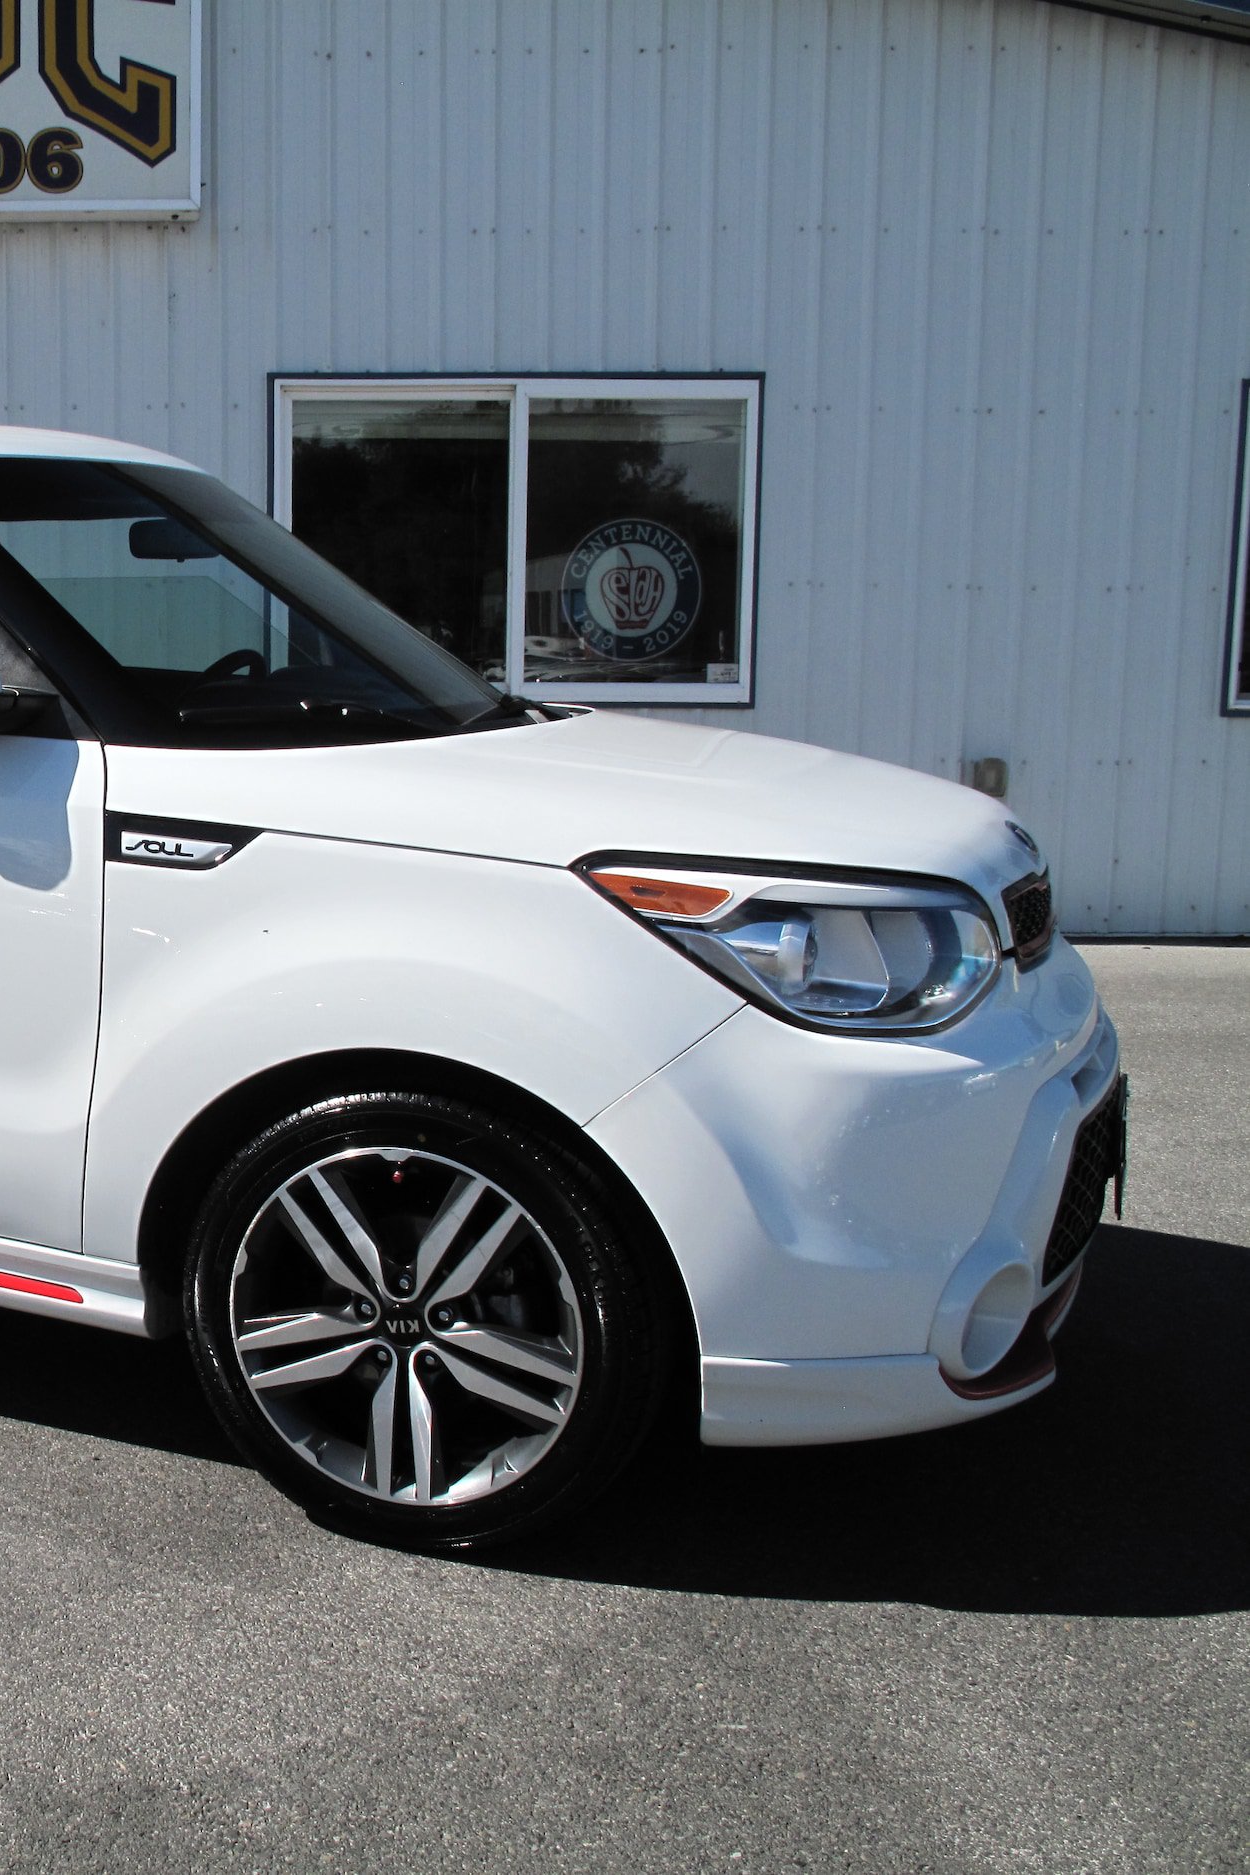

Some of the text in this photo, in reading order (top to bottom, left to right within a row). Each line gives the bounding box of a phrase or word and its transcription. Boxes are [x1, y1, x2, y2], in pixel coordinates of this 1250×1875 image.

[571, 524, 694, 580] CENTENNIAL
[574, 610, 614, 650] 1919
[643, 610, 688, 652] 2019
[385, 1319, 420, 1333] KIA
